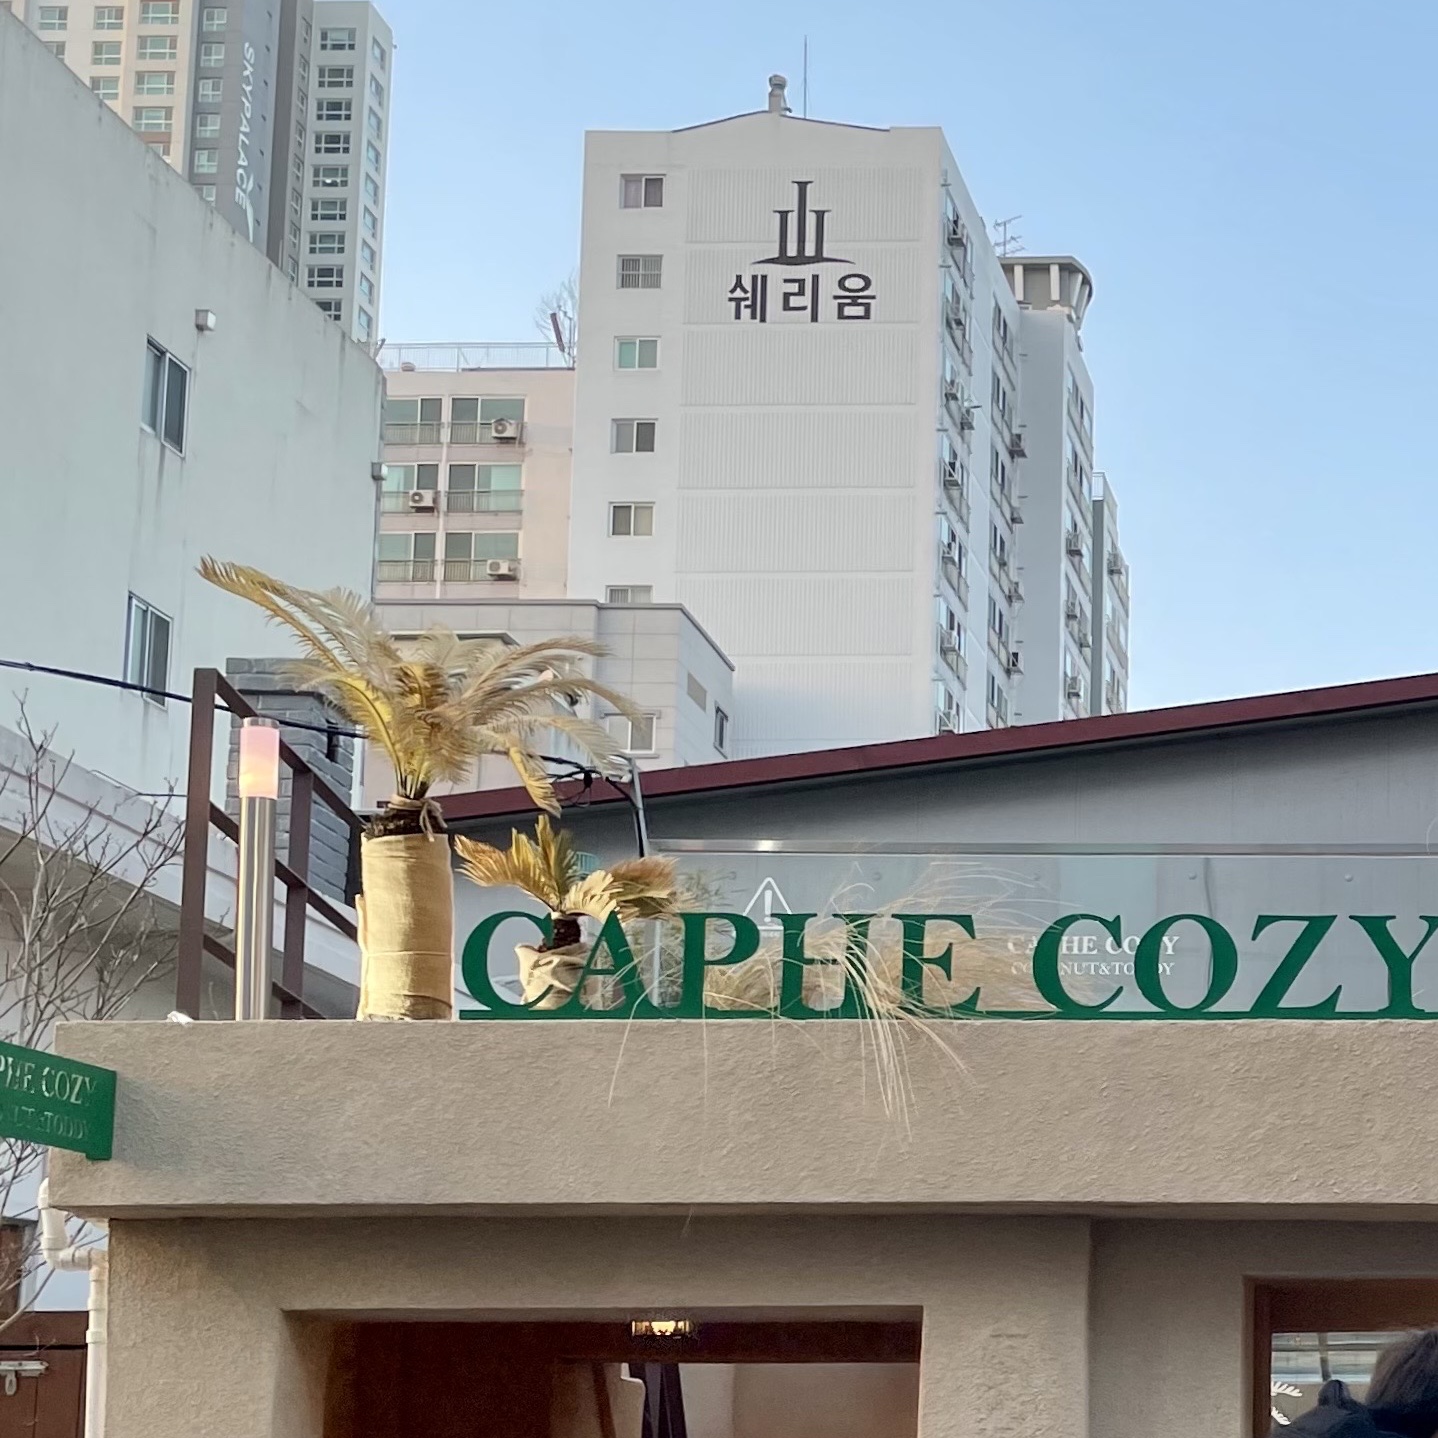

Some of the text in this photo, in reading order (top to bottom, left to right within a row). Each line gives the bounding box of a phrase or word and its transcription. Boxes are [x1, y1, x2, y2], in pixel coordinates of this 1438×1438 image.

[234, 41, 257, 211] SKYPALACE
[727, 273, 877, 323] 쉐리움
[461, 910, 979, 1013] CAPHE
[1007, 934, 1179, 955] CHE COY
[1011, 961, 1175, 976] CONUT&TOY
[41, 1066, 97, 1107] COZY
